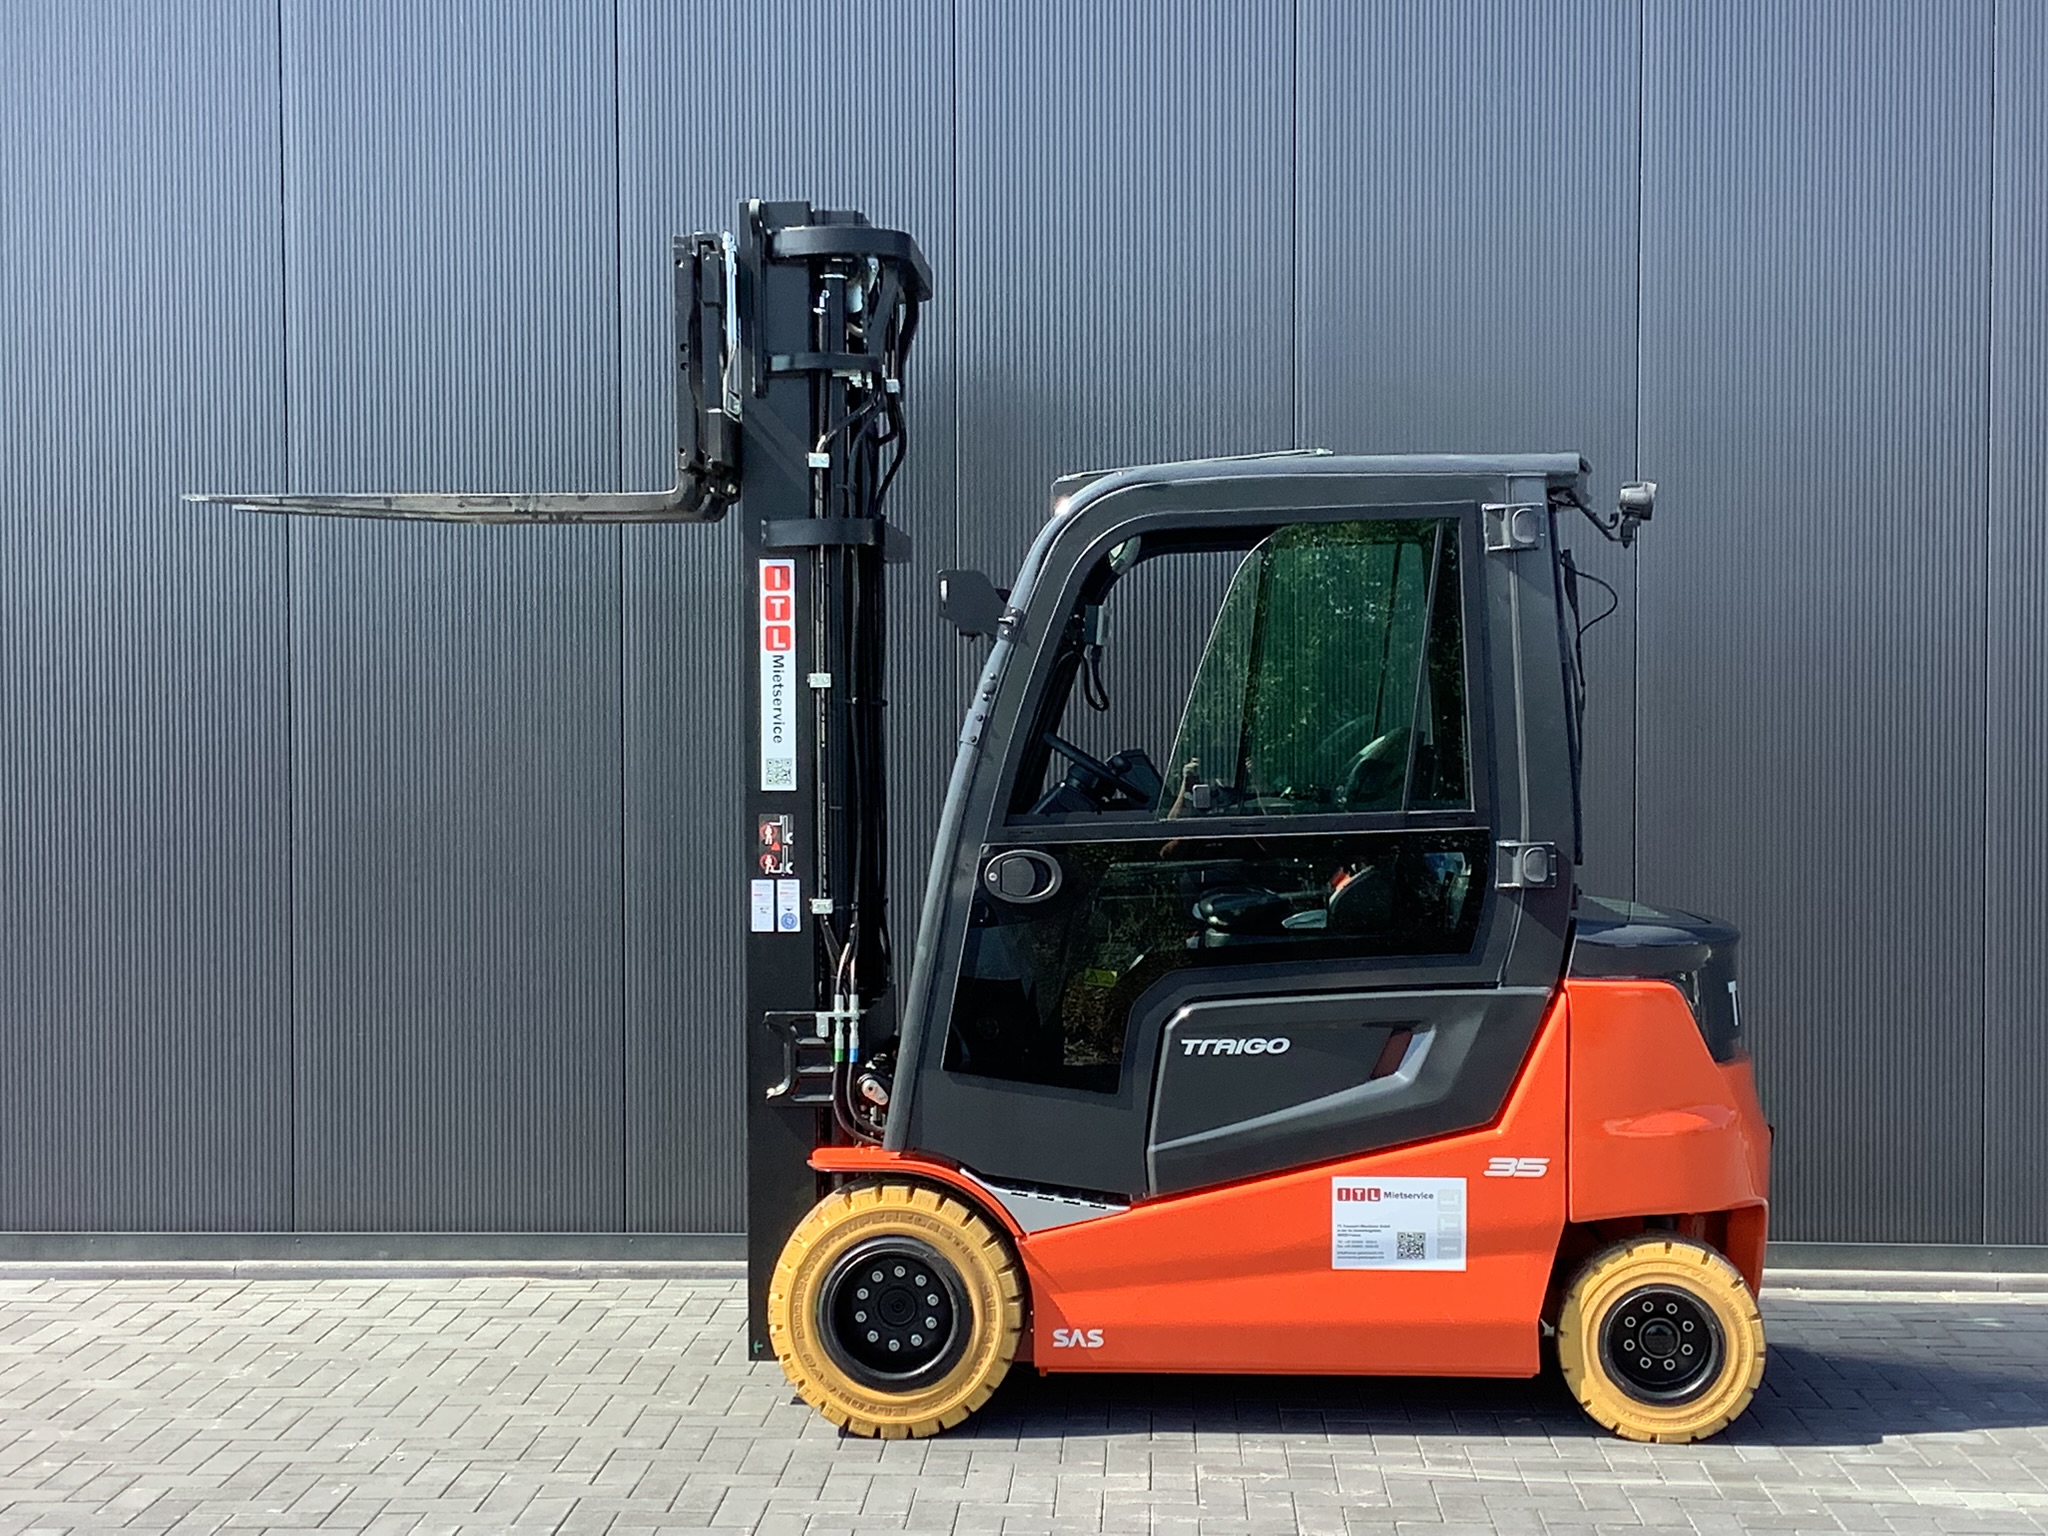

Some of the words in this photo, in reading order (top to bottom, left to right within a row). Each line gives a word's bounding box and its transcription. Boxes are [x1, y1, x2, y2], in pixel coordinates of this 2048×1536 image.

[768, 567, 788, 649] ITL
[772, 655, 785, 744] Mietservice
[1483, 1157, 1551, 1177] 35
[1339, 1189, 1380, 1201] ITL
[1384, 1191, 1434, 1200] Mietservice
[1052, 1328, 1104, 1348] SAS
